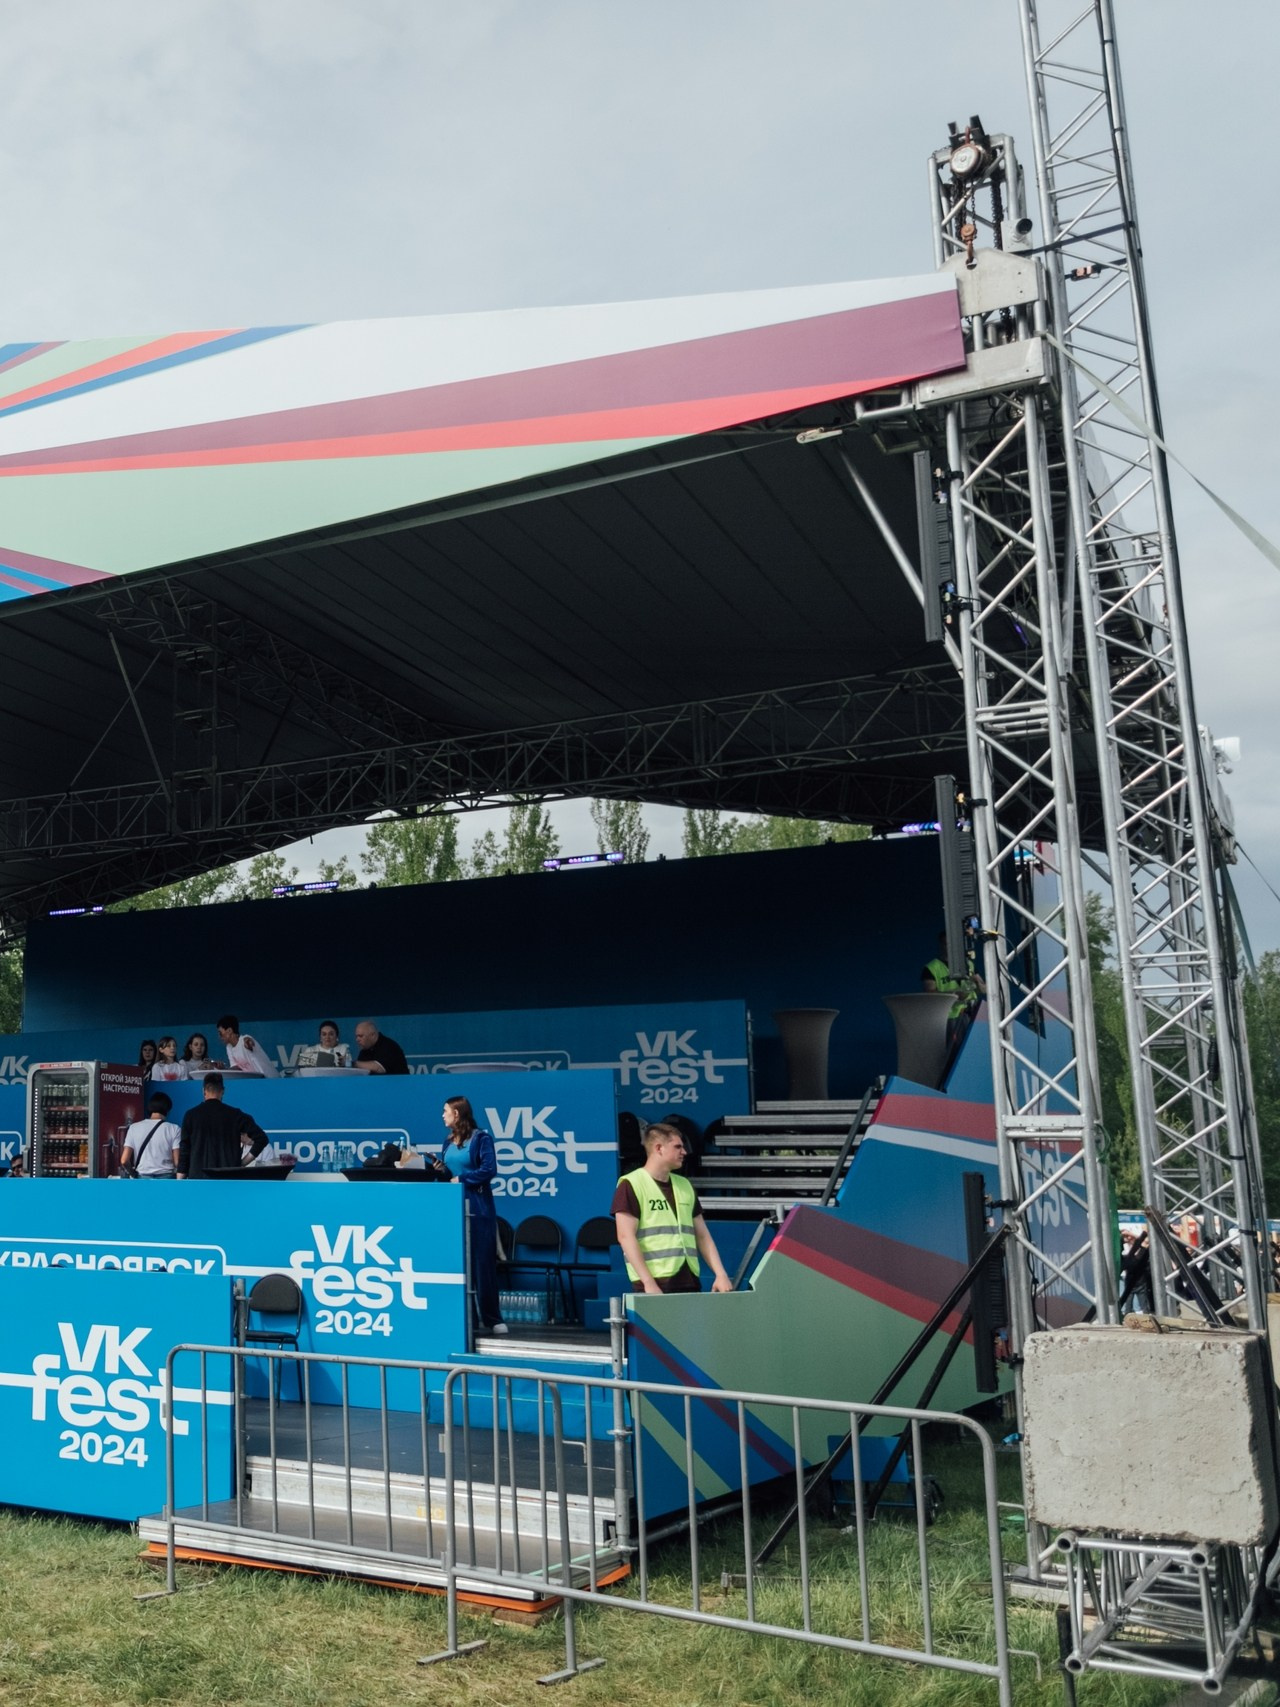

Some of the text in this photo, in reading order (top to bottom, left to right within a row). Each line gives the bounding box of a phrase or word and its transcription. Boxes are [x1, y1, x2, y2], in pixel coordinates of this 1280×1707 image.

[635, 1029, 698, 1057] VK
[100, 1073, 143, 1086] ОТКРОЙ ЗАРЯД
[620, 1050, 724, 1085] fest
[103, 1083, 140, 1094] НАСТРОЕНИЯ
[640, 1087, 699, 1104] 2024
[484, 1106, 558, 1138] VK
[495, 1131, 588, 1174] est
[492, 1177, 558, 1197] 2024
[310, 1224, 394, 1265] VK
[289, 1249, 428, 1310] fest
[315, 1310, 394, 1337] 2024
[57, 1322, 153, 1377] VK
[58, 1429, 149, 1468] 2024
